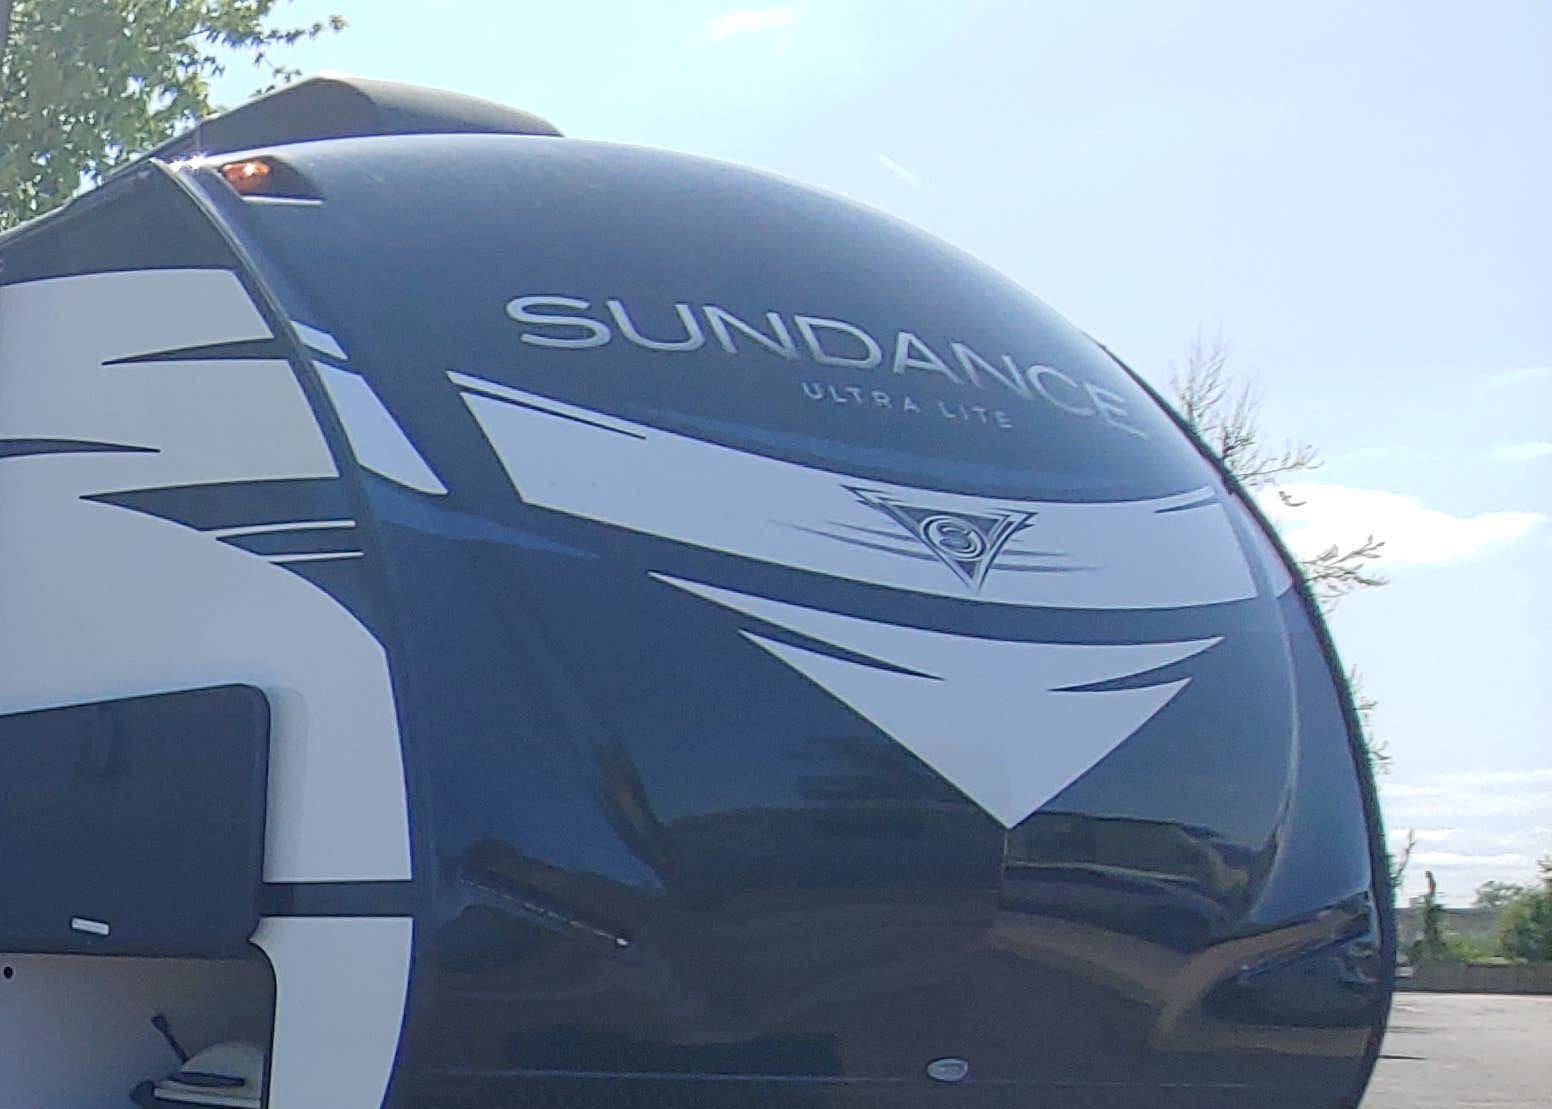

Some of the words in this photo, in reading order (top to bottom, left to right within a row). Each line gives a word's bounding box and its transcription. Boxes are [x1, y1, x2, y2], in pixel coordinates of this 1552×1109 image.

[505, 294, 1149, 440] SUNDANCE
[801, 381, 921, 414] ULTRA
[938, 401, 1014, 429] LITE
